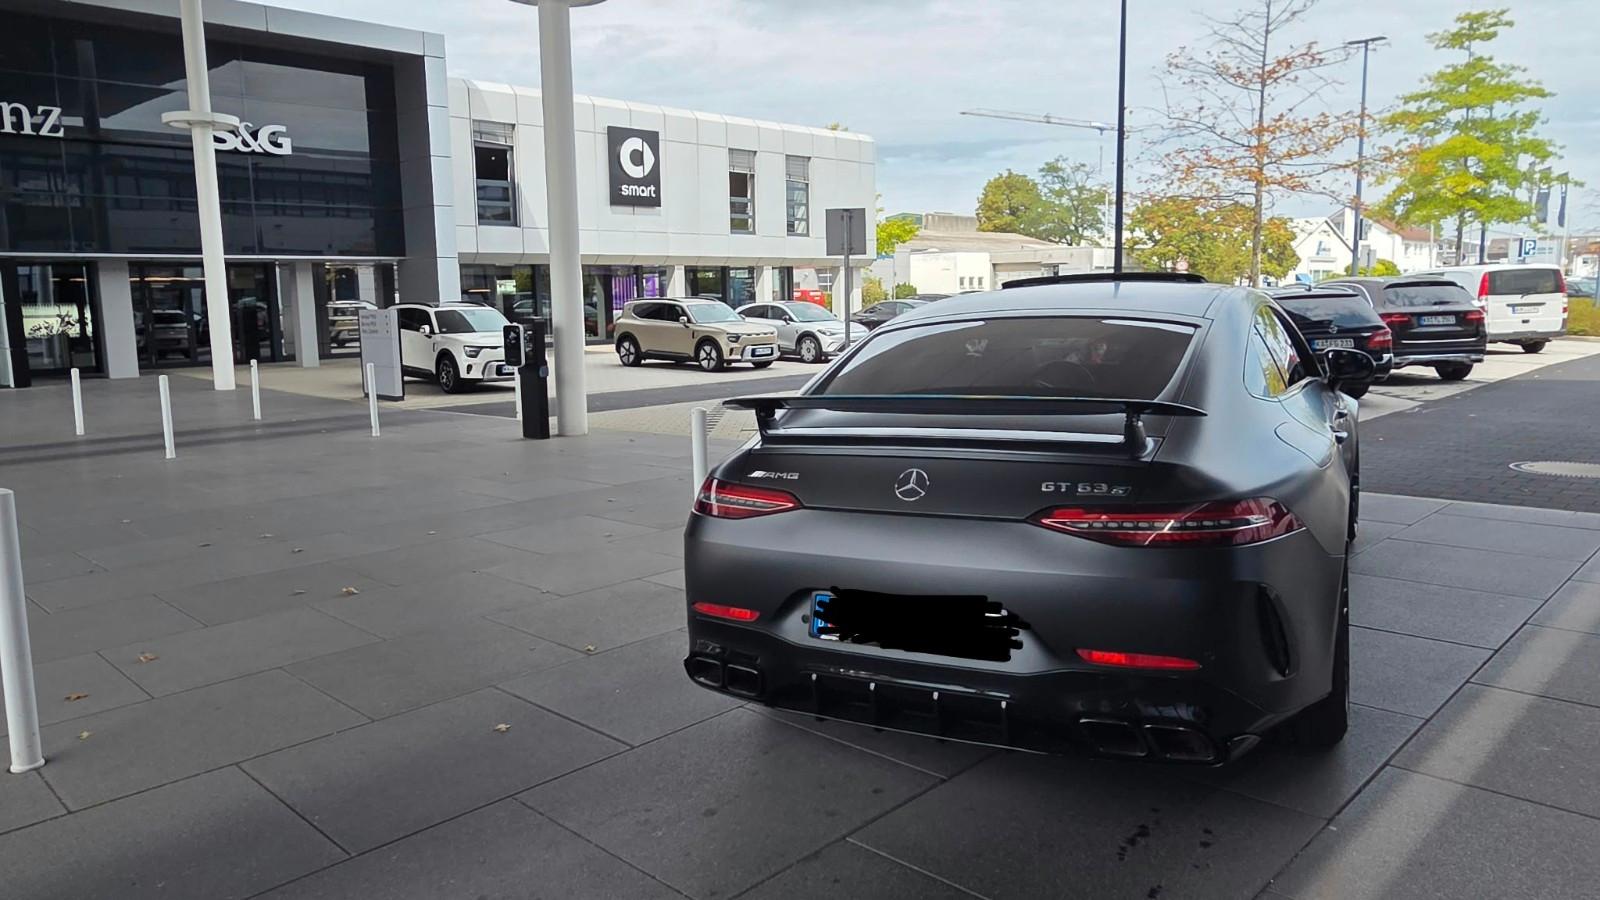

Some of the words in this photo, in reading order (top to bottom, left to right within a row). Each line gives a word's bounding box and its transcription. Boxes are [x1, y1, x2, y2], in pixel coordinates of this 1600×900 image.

[621, 184, 656, 198] smart
[762, 471, 800, 480] AMG
[1041, 482, 1071, 492] GT
